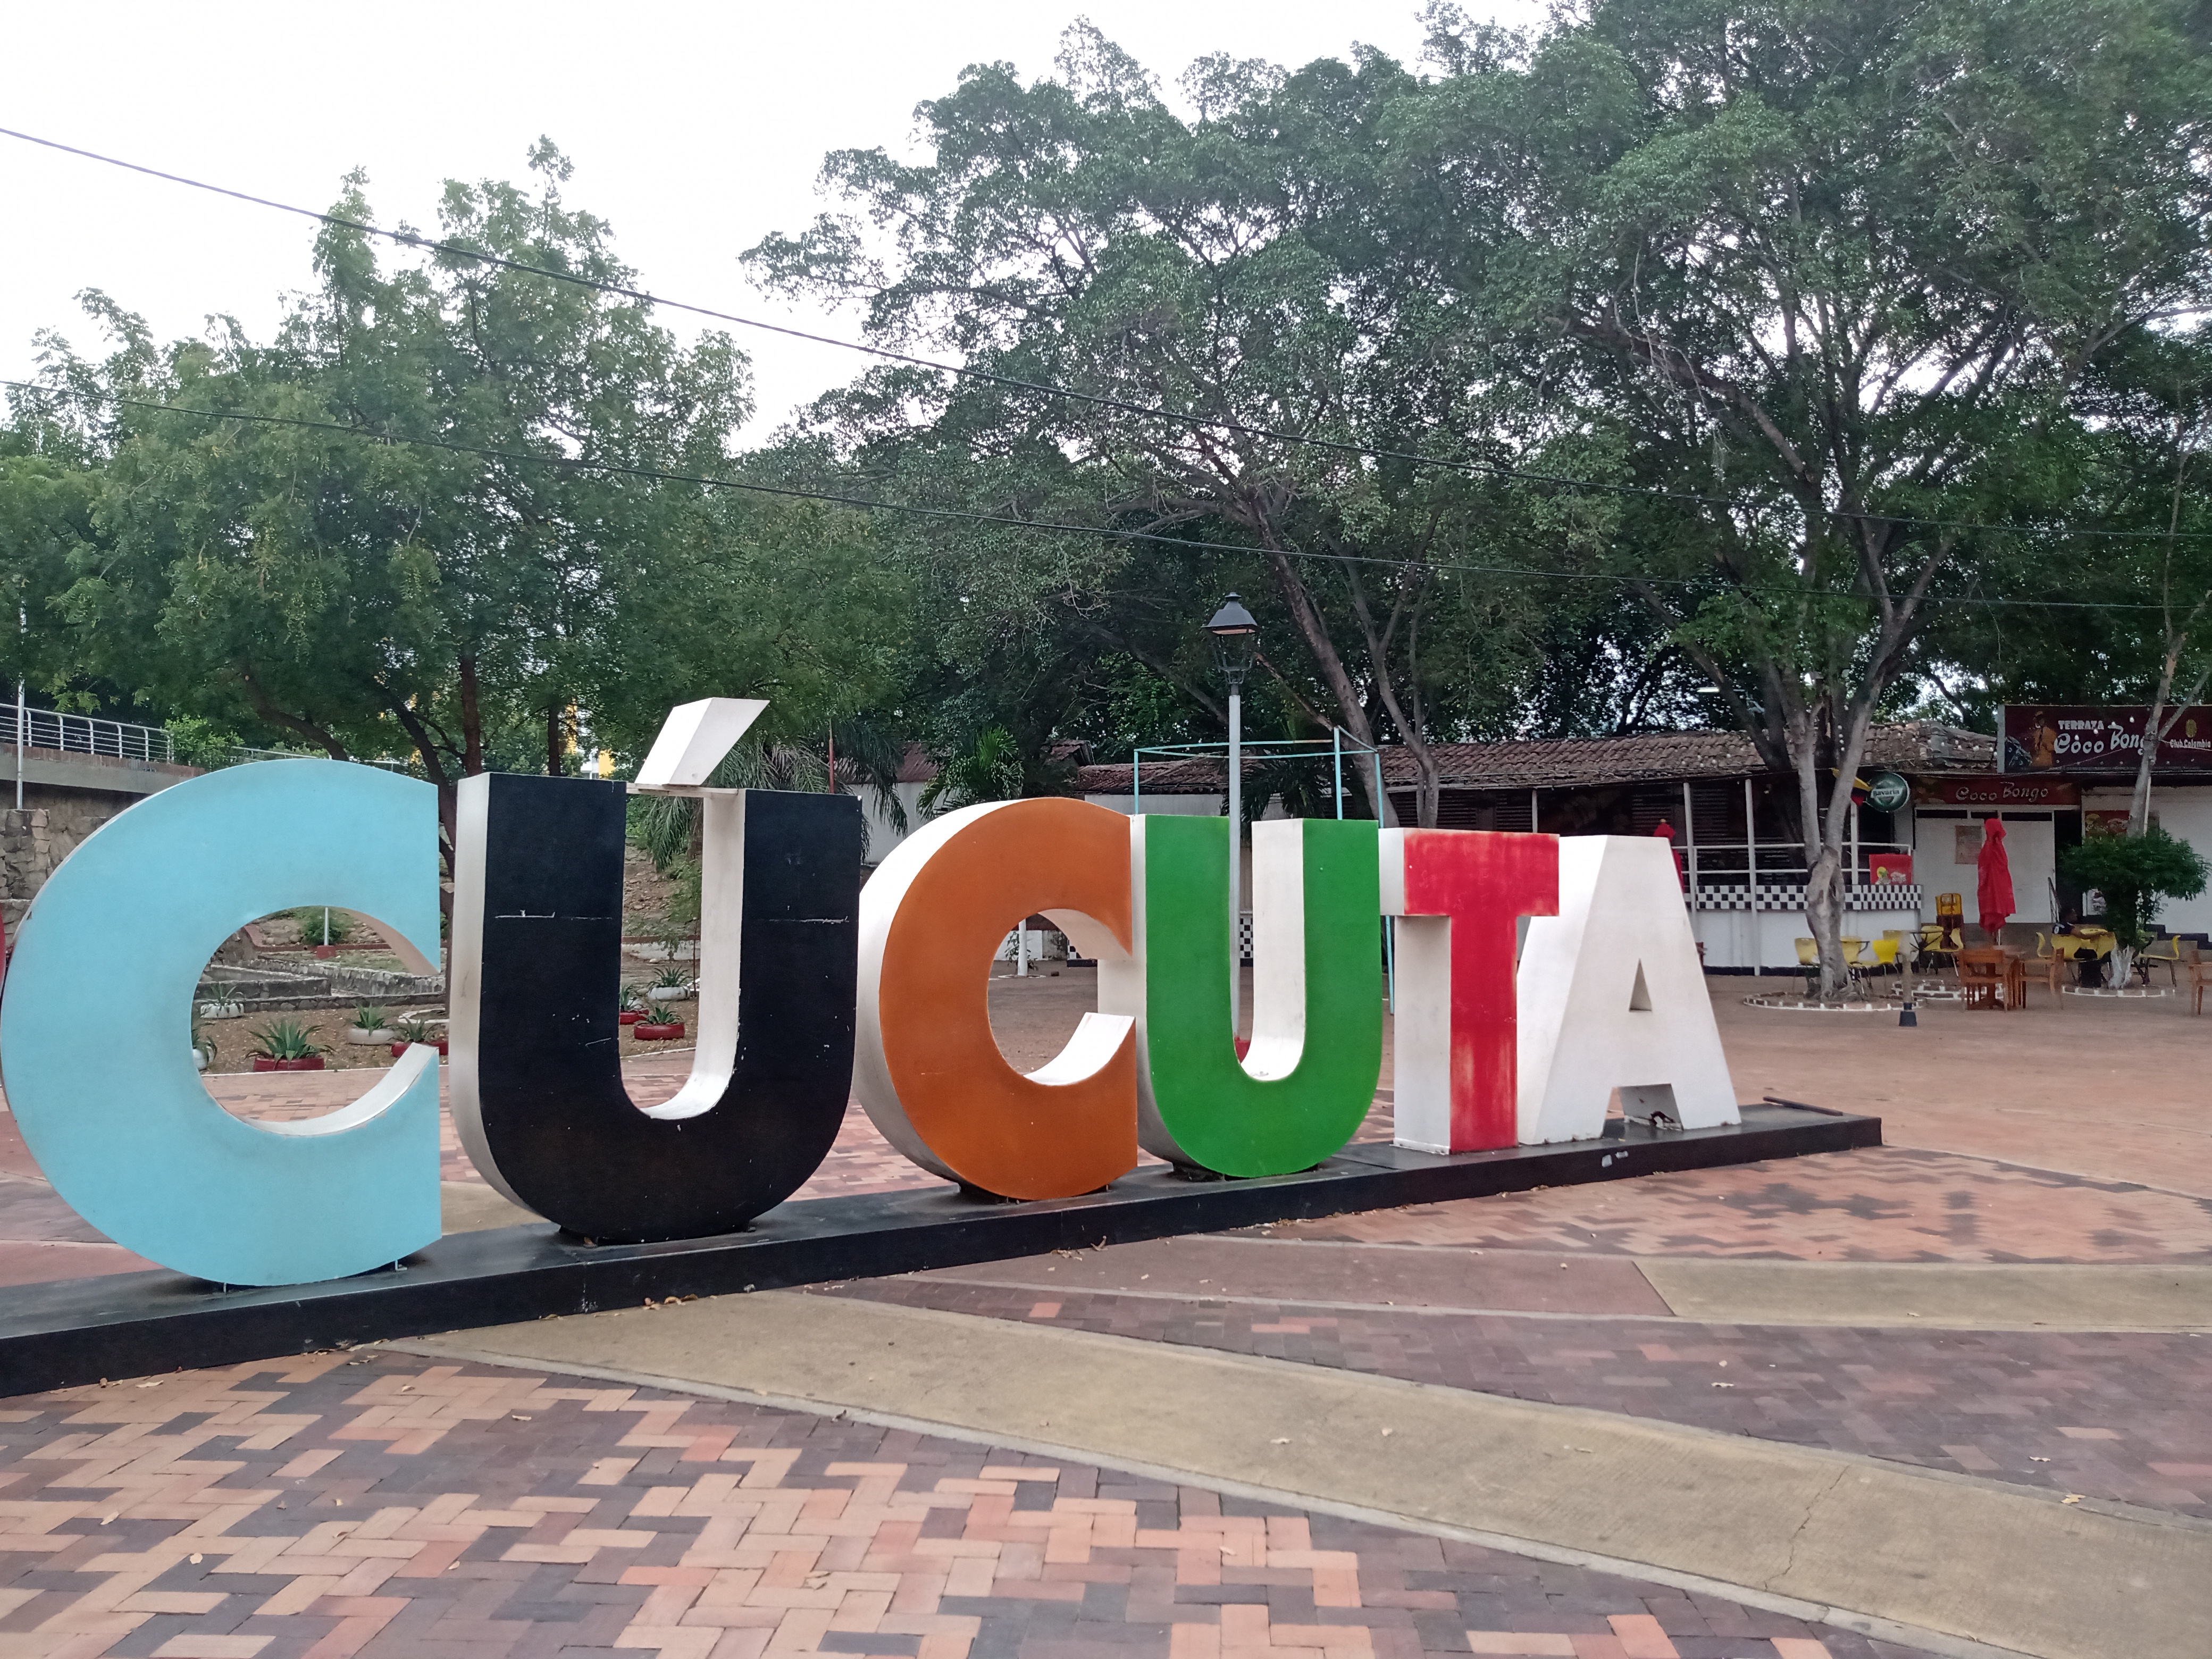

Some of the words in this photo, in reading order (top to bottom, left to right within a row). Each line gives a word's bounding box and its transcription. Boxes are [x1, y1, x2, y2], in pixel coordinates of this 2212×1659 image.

[2058, 720, 2104, 730] TERRAZA
[2054, 733, 2104, 753] Coco
[2108, 725, 2144, 755] Bon
[2170, 739, 2183, 748] Club
[2184, 739, 2211, 748] Colombia
[1956, 786, 1997, 801] Coco
[2000, 782, 2048, 802] Bongo
[1, 697, 1742, 1287] CÚCUTA
